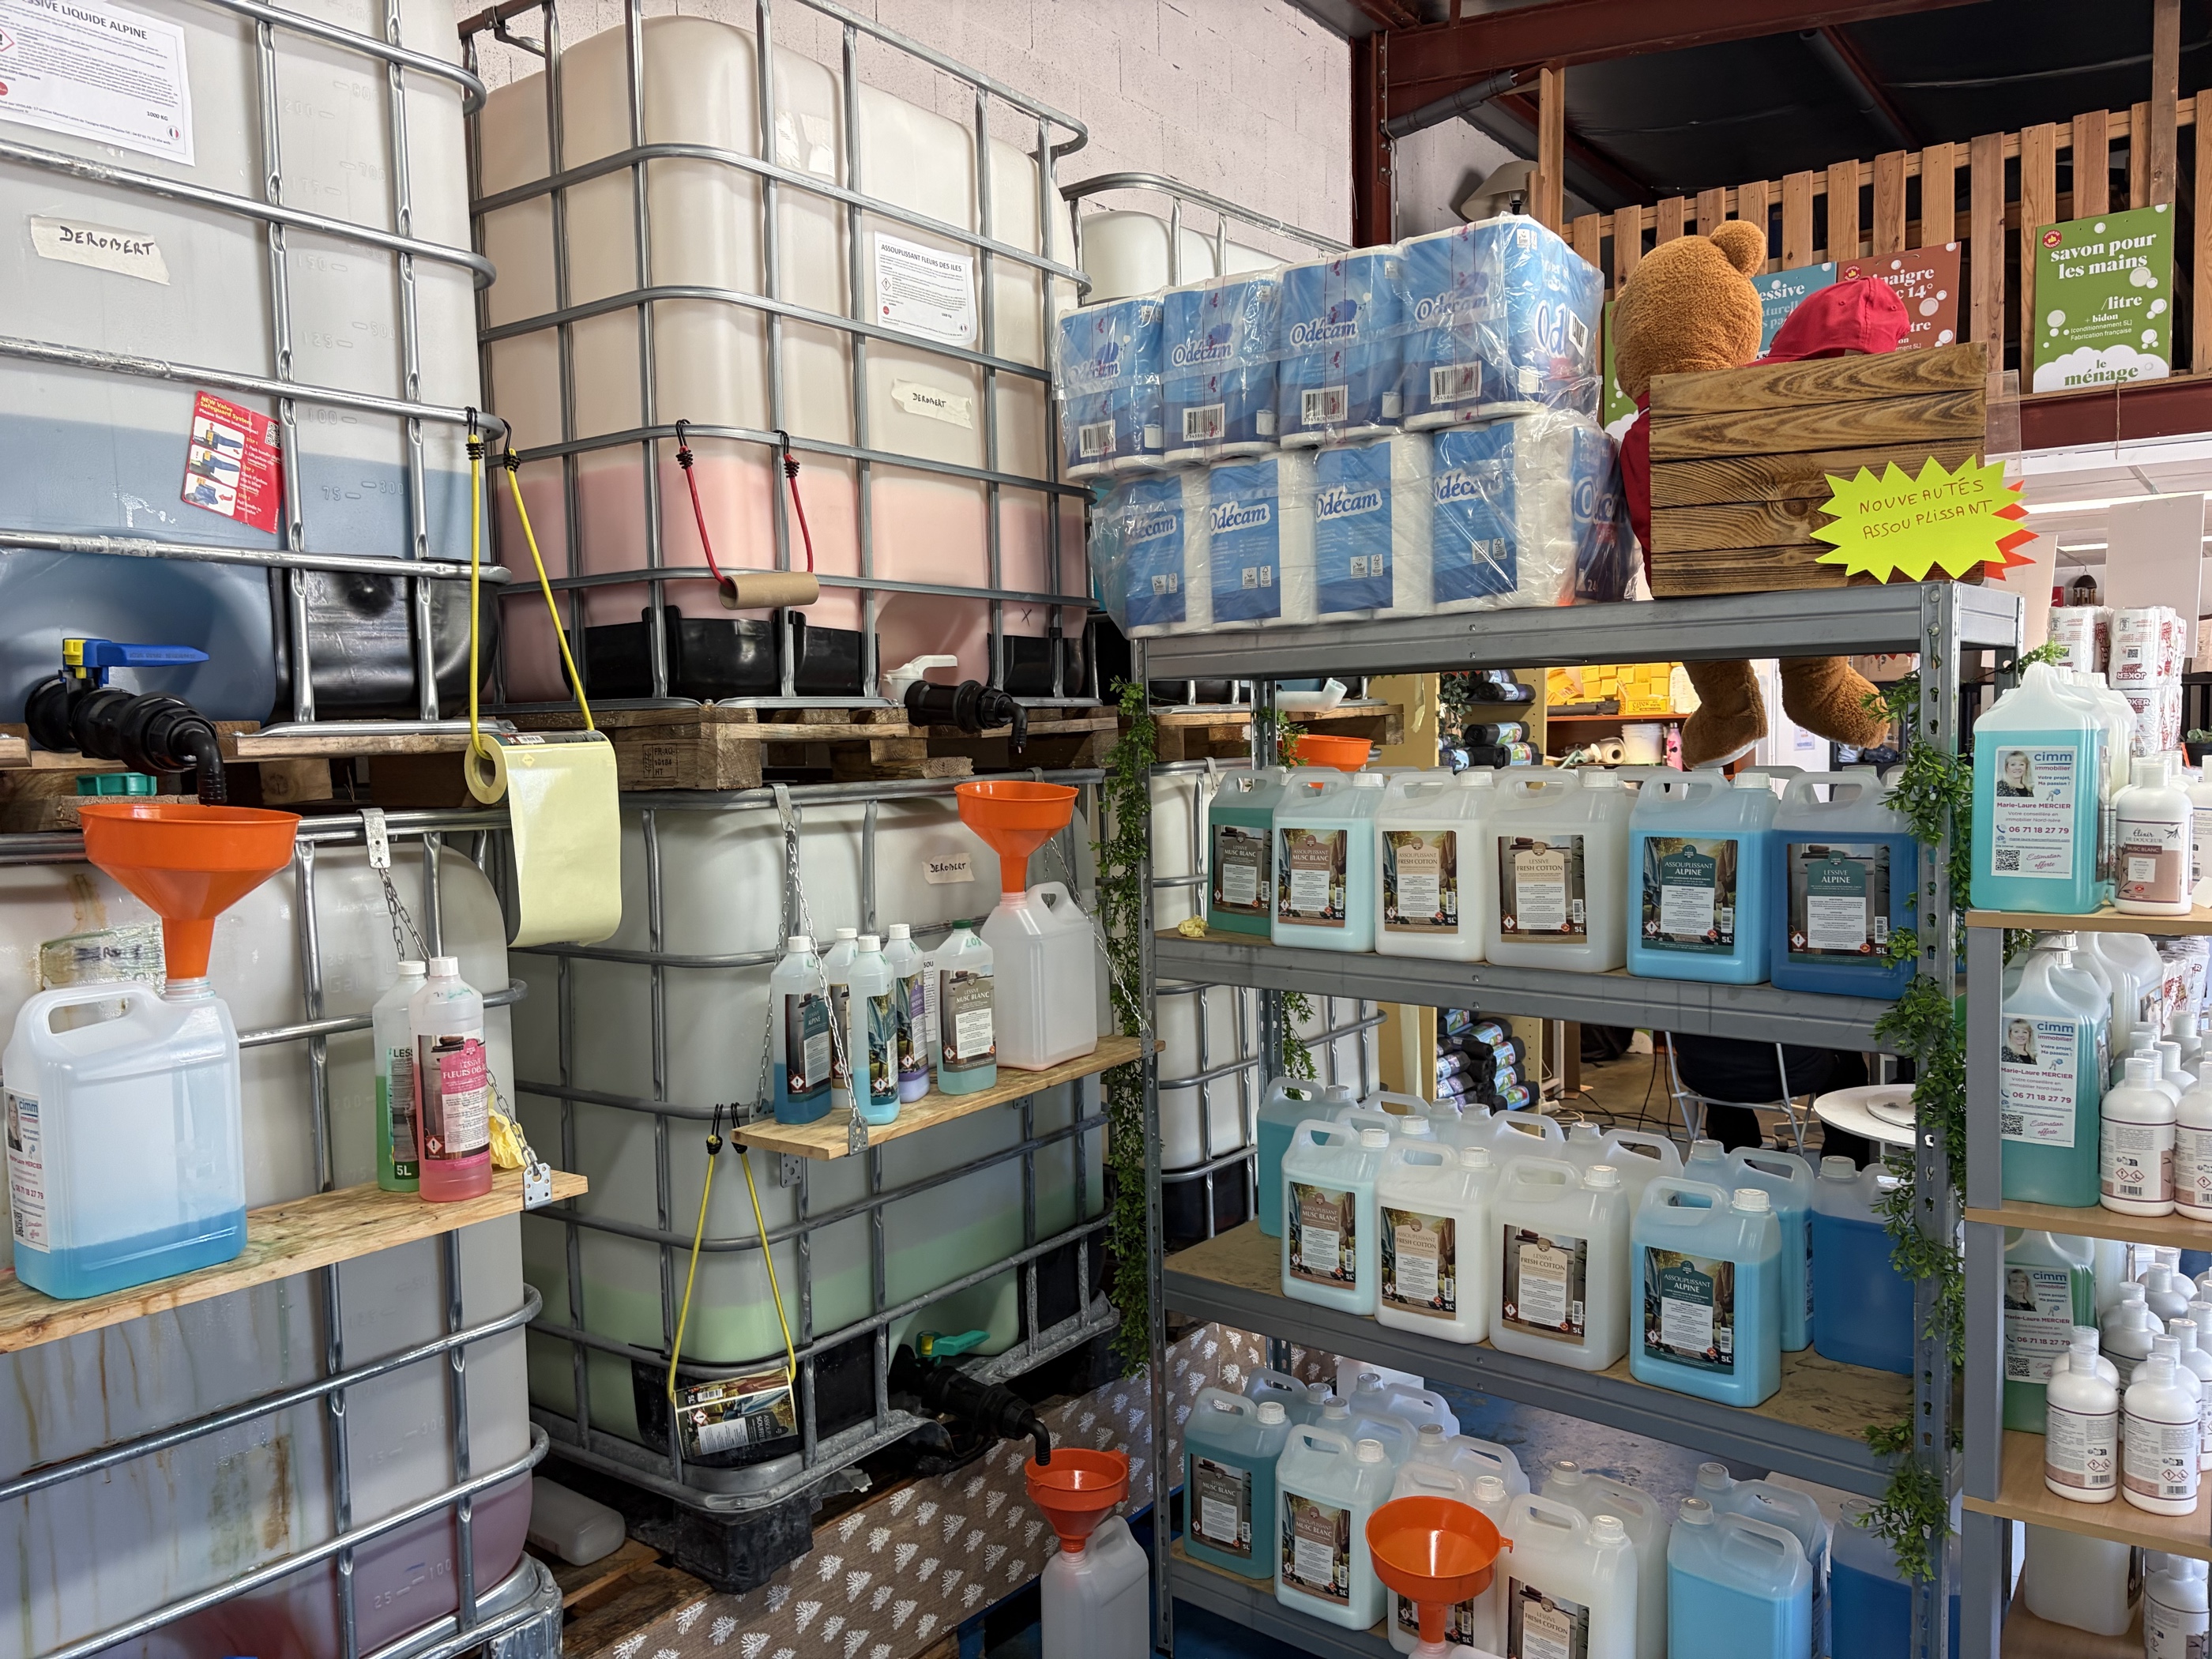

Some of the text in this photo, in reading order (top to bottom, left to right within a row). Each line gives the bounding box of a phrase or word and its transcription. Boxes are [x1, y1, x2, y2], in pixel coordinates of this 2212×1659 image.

[62, 6, 147, 40] LIQUIDE ALPINE
[285, 100, 314, 117] 200
[59, 225, 154, 255] DEROBERT
[2051, 234, 2157, 262] savon pour
[297, 254, 326, 271] 150
[881, 243, 920, 261] ASSOUPLISSANT
[921, 256, 939, 268] FLEURS
[2059, 254, 2148, 280] les mains
[1907, 282, 1934, 299] 14°
[2101, 295, 2142, 310] /litre
[2093, 313, 2119, 323] bidon
[371, 322, 396, 340] 500
[1292, 318, 1356, 344] Odécam
[2071, 320, 2123, 334] (conditionnement
[2071, 327, 2132, 340] Fabrication française
[303, 331, 333, 348] 125
[2096, 359, 2107, 369] le
[2063, 366, 2139, 386] ménage
[200, 396, 233, 412] NEW Valve
[199, 408, 215, 417] Please
[200, 401, 253, 427] Safeguard System
[308, 408, 337, 424] 100
[322, 487, 341, 502] 75
[379, 480, 404, 495] 300
[1317, 491, 1379, 519] Odécam
[2034, 751, 2072, 762] cimm
[971, 991, 990, 1001] BLANC
[2037, 1021, 2074, 1033] cimm
[442, 1066, 483, 1079] FLEURS DES
[2001, 1067, 2040, 1076] Marie-Laure
[19, 1100, 38, 1112] cimm
[25, 1159, 42, 1170] MERCIER
[396, 1164, 412, 1176] 5L
[1303, 1210, 1338, 1222] MUSC BLANC
[1304, 1206, 1337, 1215] ASSOUPLISSANT
[1396, 1237, 1437, 1250] FRESH COTTON
[1398, 1232, 1436, 1243] ASSOUPLISSANT
[1521, 1257, 1566, 1270] FRESH COTTON
[1533, 1253, 1553, 1262] LESSIVE
[1664, 1274, 1711, 1288] ASSOUPLISSANT
[2033, 1271, 2067, 1281] cimm
[1674, 1282, 1700, 1293] ALPINE
[429, 1559, 452, 1580] 100
[374, 1590, 392, 1609] 25
